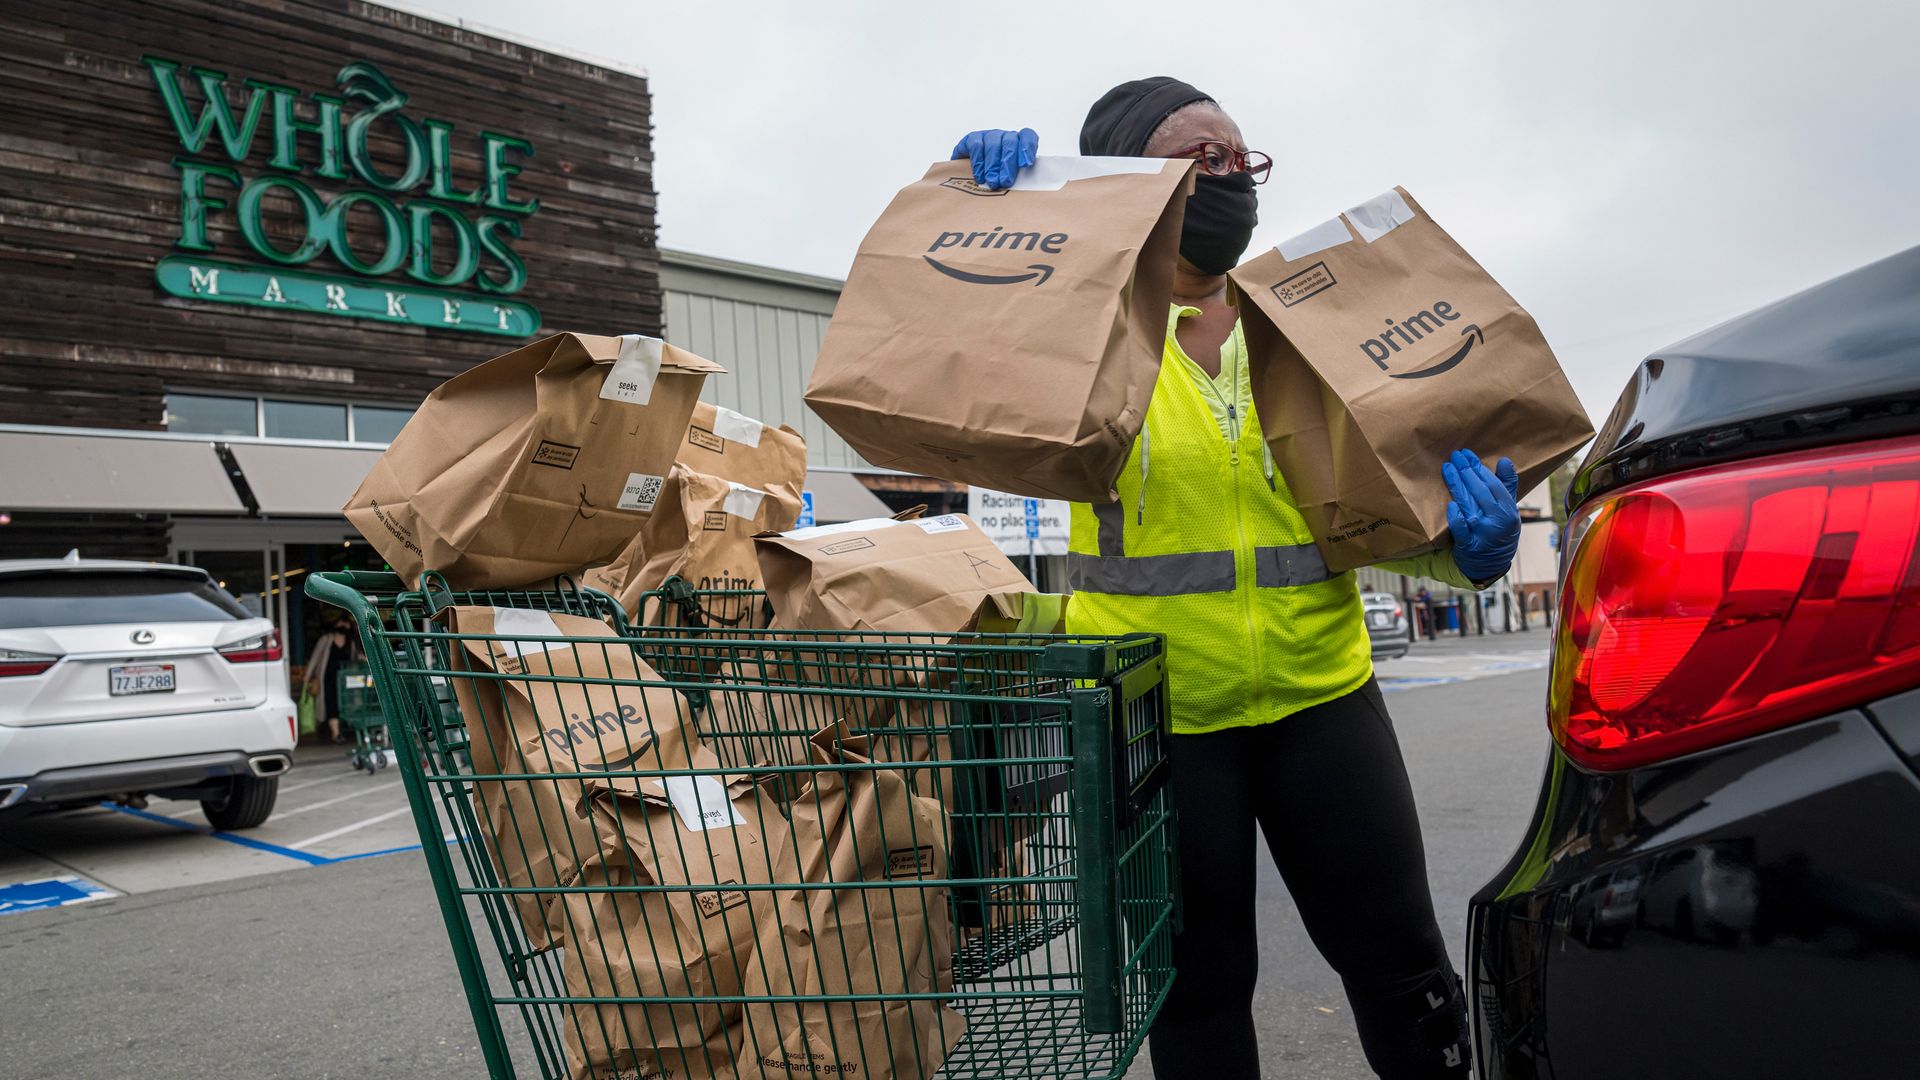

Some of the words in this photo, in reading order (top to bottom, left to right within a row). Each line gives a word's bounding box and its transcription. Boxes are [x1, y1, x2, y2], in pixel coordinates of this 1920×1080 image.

[141, 54, 540, 215] WHOLE
[171, 156, 528, 295] FOODS
[927, 226, 1069, 254] prime
[189, 266, 513, 330] MARKET
[1360, 301, 1461, 371] prime
[618, 381, 638, 392] seeks
[383, 518, 405, 543] handle
[982, 516, 998, 528] no
[541, 704, 643, 757] prime
[823, 1062, 858, 1075] getly
